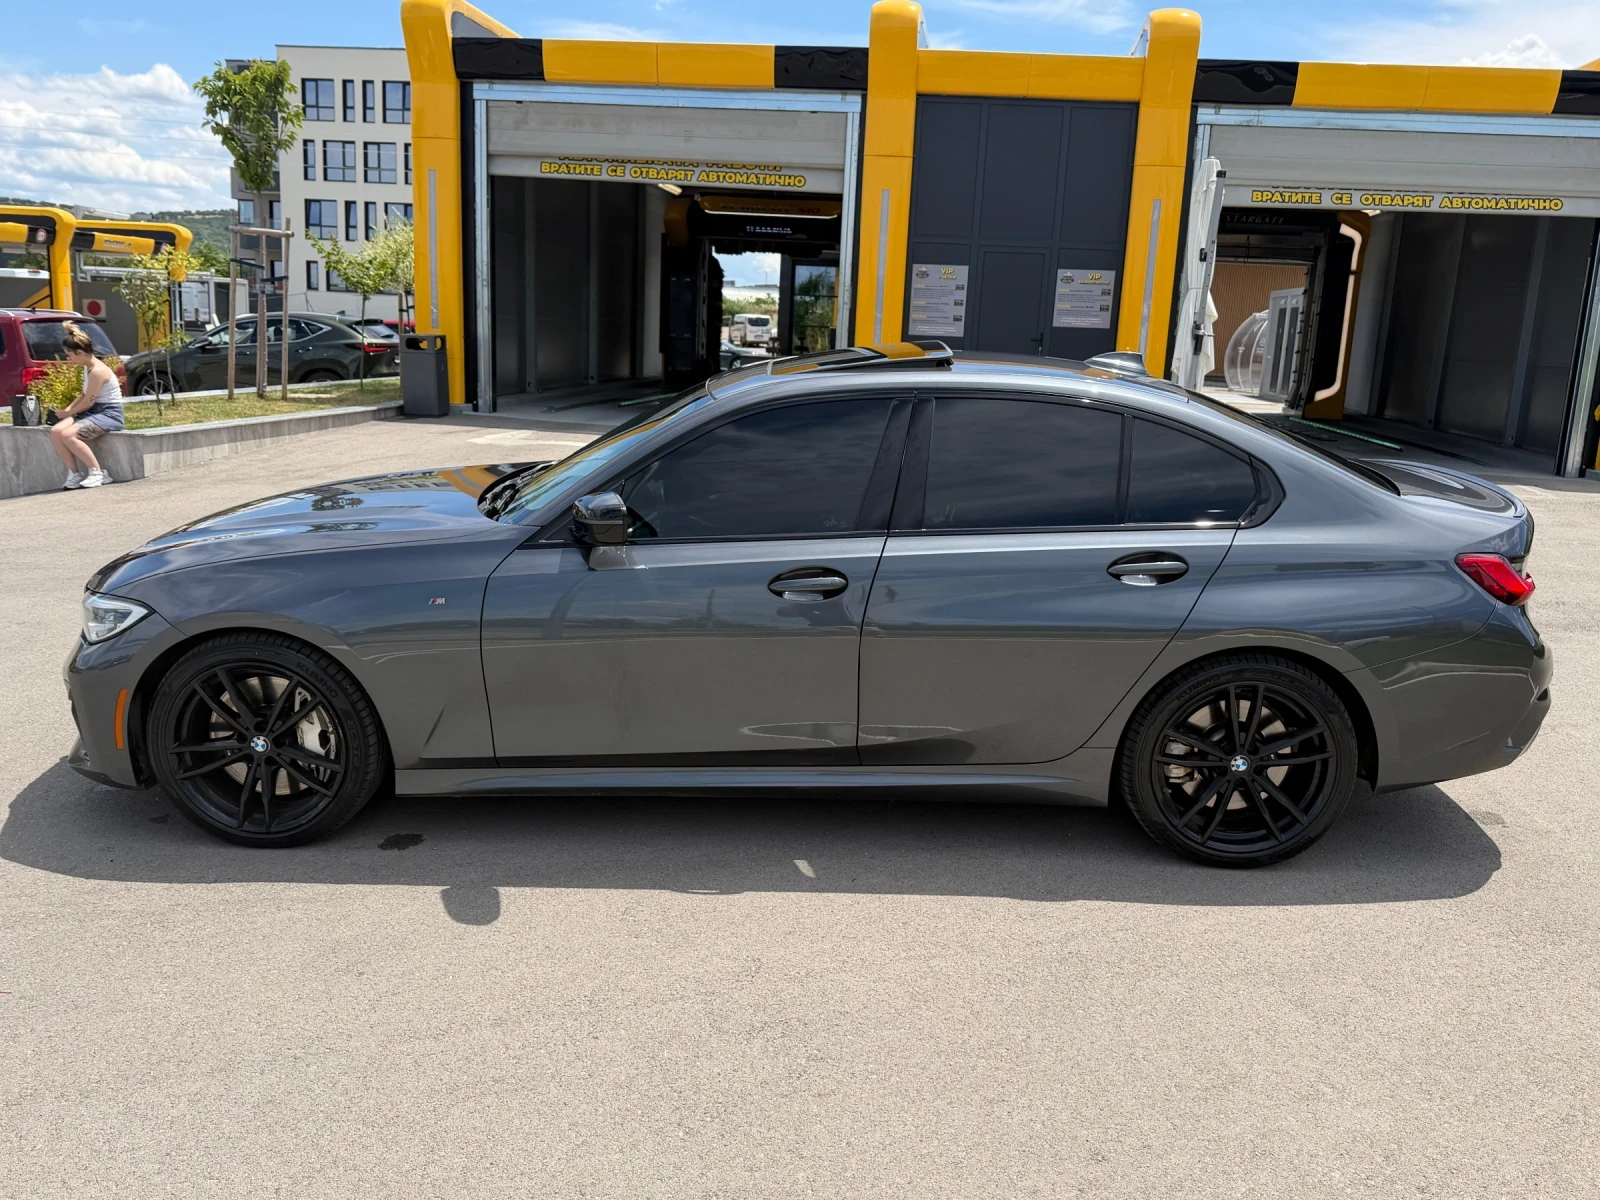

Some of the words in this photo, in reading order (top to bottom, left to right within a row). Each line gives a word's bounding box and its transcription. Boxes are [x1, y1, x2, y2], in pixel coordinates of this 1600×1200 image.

[540, 161, 601, 175] ВРАТИТЕ
[607, 165, 625, 177] СЕ
[630, 166, 694, 181] ОТВАРЯТ
[697, 171, 806, 188] АВТОМАТИЧНО
[1252, 190, 1322, 204] ВРАТИТЕ
[1331, 192, 1352, 205] СЕ
[1360, 193, 1433, 207] ОТВАРЯТ
[1439, 196, 1563, 211] АВТОМАТИЧНО
[1225, 214, 1285, 224] STARGATE
[940, 267, 955, 275] VIP
[296, 661, 339, 699] KUMHO
[1176, 673, 1221, 701] KUMHO
